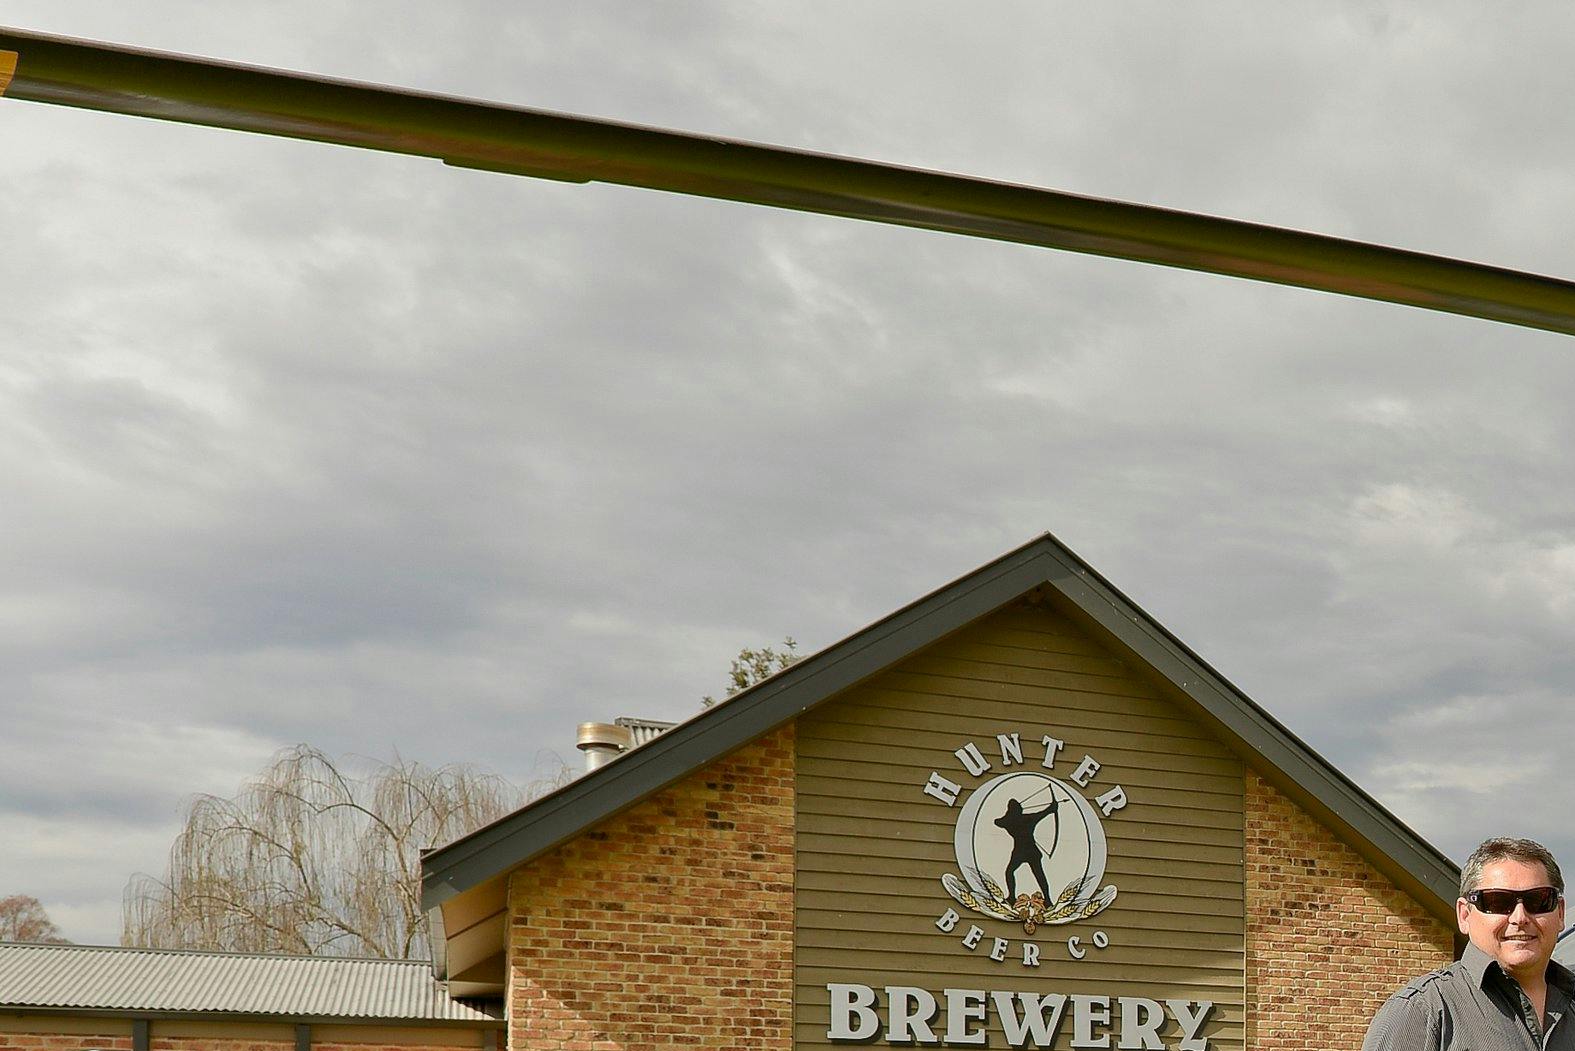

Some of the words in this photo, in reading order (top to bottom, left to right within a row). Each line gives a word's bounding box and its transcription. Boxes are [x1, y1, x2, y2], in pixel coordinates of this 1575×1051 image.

[924, 733, 1127, 817] HUNTER
[935, 907, 1040, 967] BEER
[1067, 930, 1109, 959] CO
[826, 983, 1213, 1051] BREWERY
